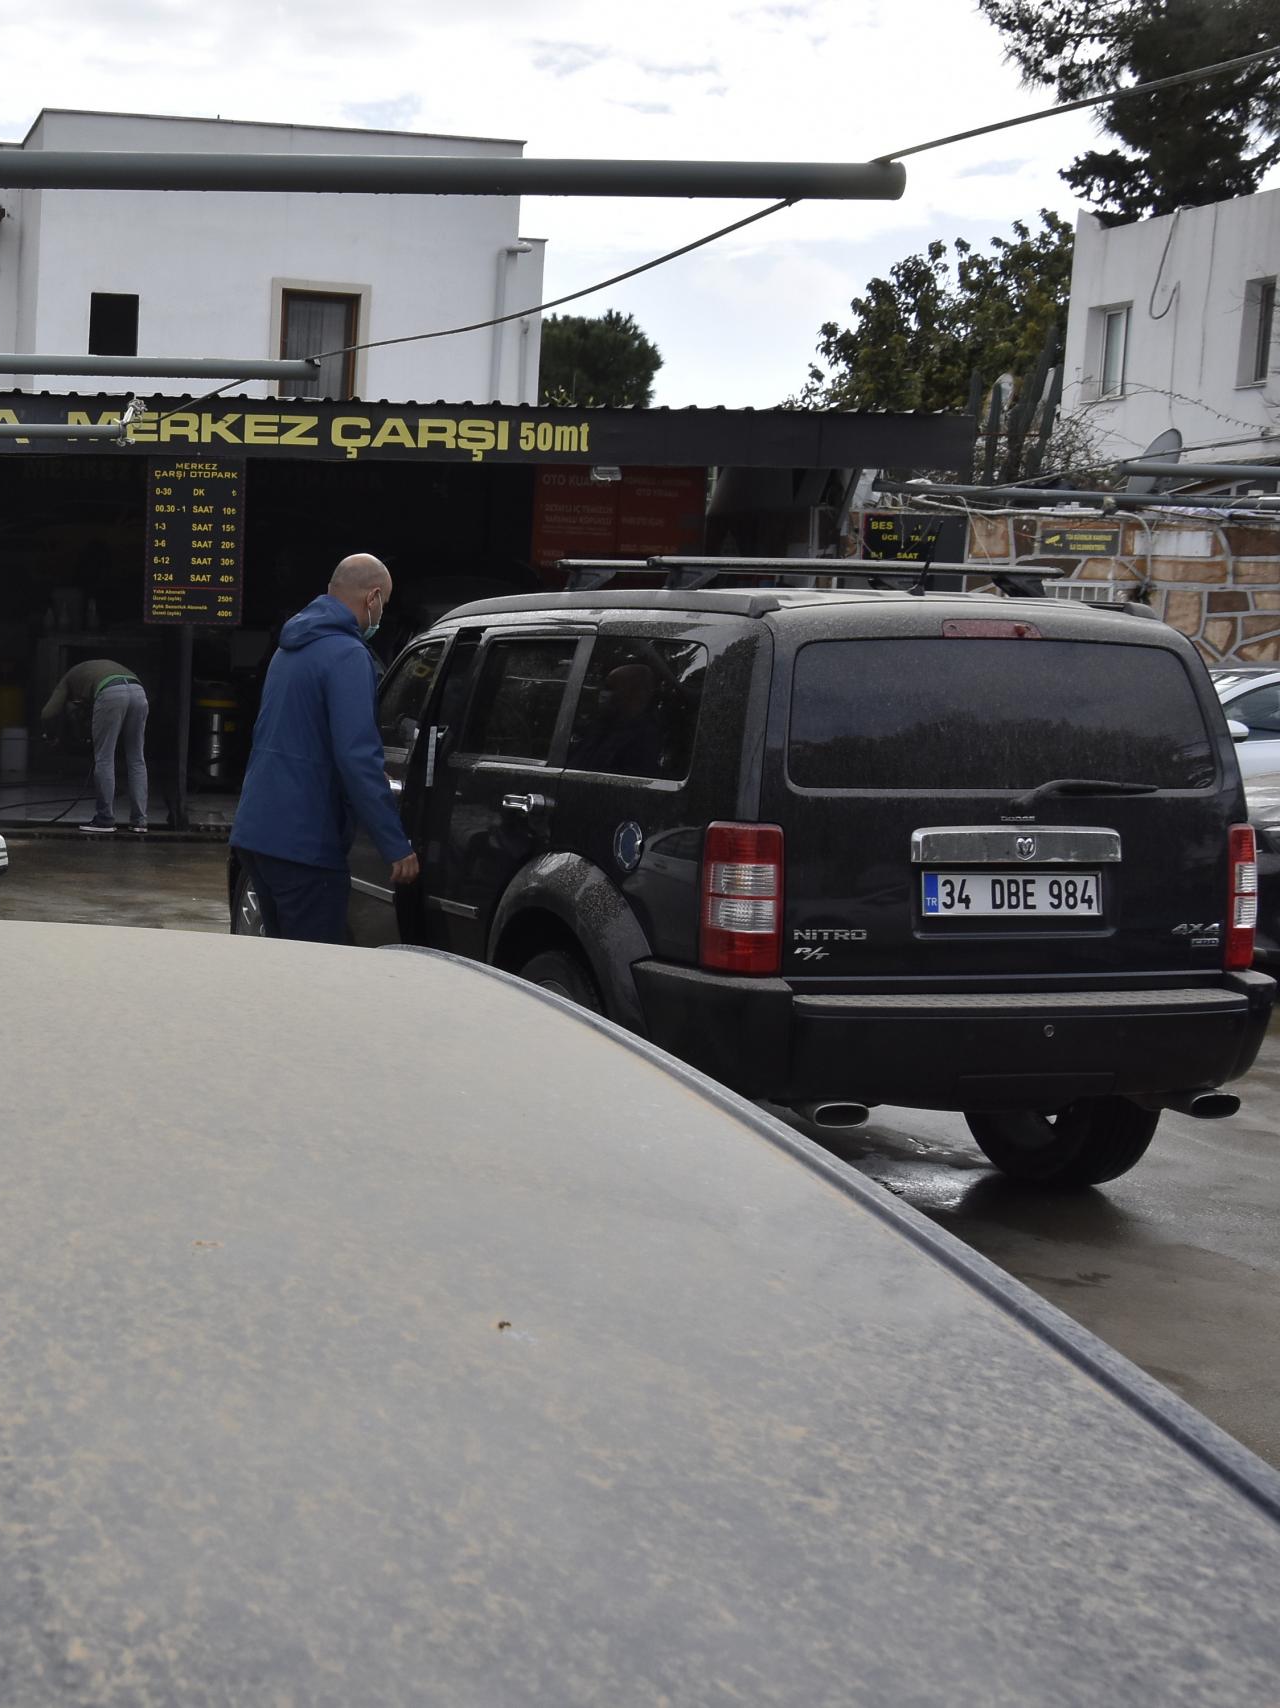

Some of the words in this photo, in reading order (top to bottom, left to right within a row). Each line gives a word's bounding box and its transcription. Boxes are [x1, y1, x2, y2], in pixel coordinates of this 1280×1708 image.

[67, 411, 318, 446] MERKEZ
[331, 416, 510, 462] ÇARŞI
[519, 422, 590, 452] 50mt
[175, 462, 218, 470] MERKEZ
[154, 470, 186, 480] ÇARŞI
[190, 471, 238, 479] OTOPARK
[155, 487, 172, 496] 0-30
[193, 488, 205, 496] DK
[192, 505, 214, 513] SAAT
[154, 522, 166, 530] 1-3
[191, 523, 213, 531] SAAT
[154, 539, 166, 547] 3-6
[191, 540, 213, 548] SAAT
[153, 556, 170, 564] 6-12
[191, 557, 212, 565] SAAT
[152, 573, 173, 581] 12-24
[189, 574, 211, 582] SAAT
[926, 897, 937, 906] TR
[941, 879, 972, 910] 34
[991, 879, 1037, 910] DBE
[1048, 879, 1094, 910] 984
[793, 929, 867, 941] NITRO
[793, 946, 830, 961] R/T
